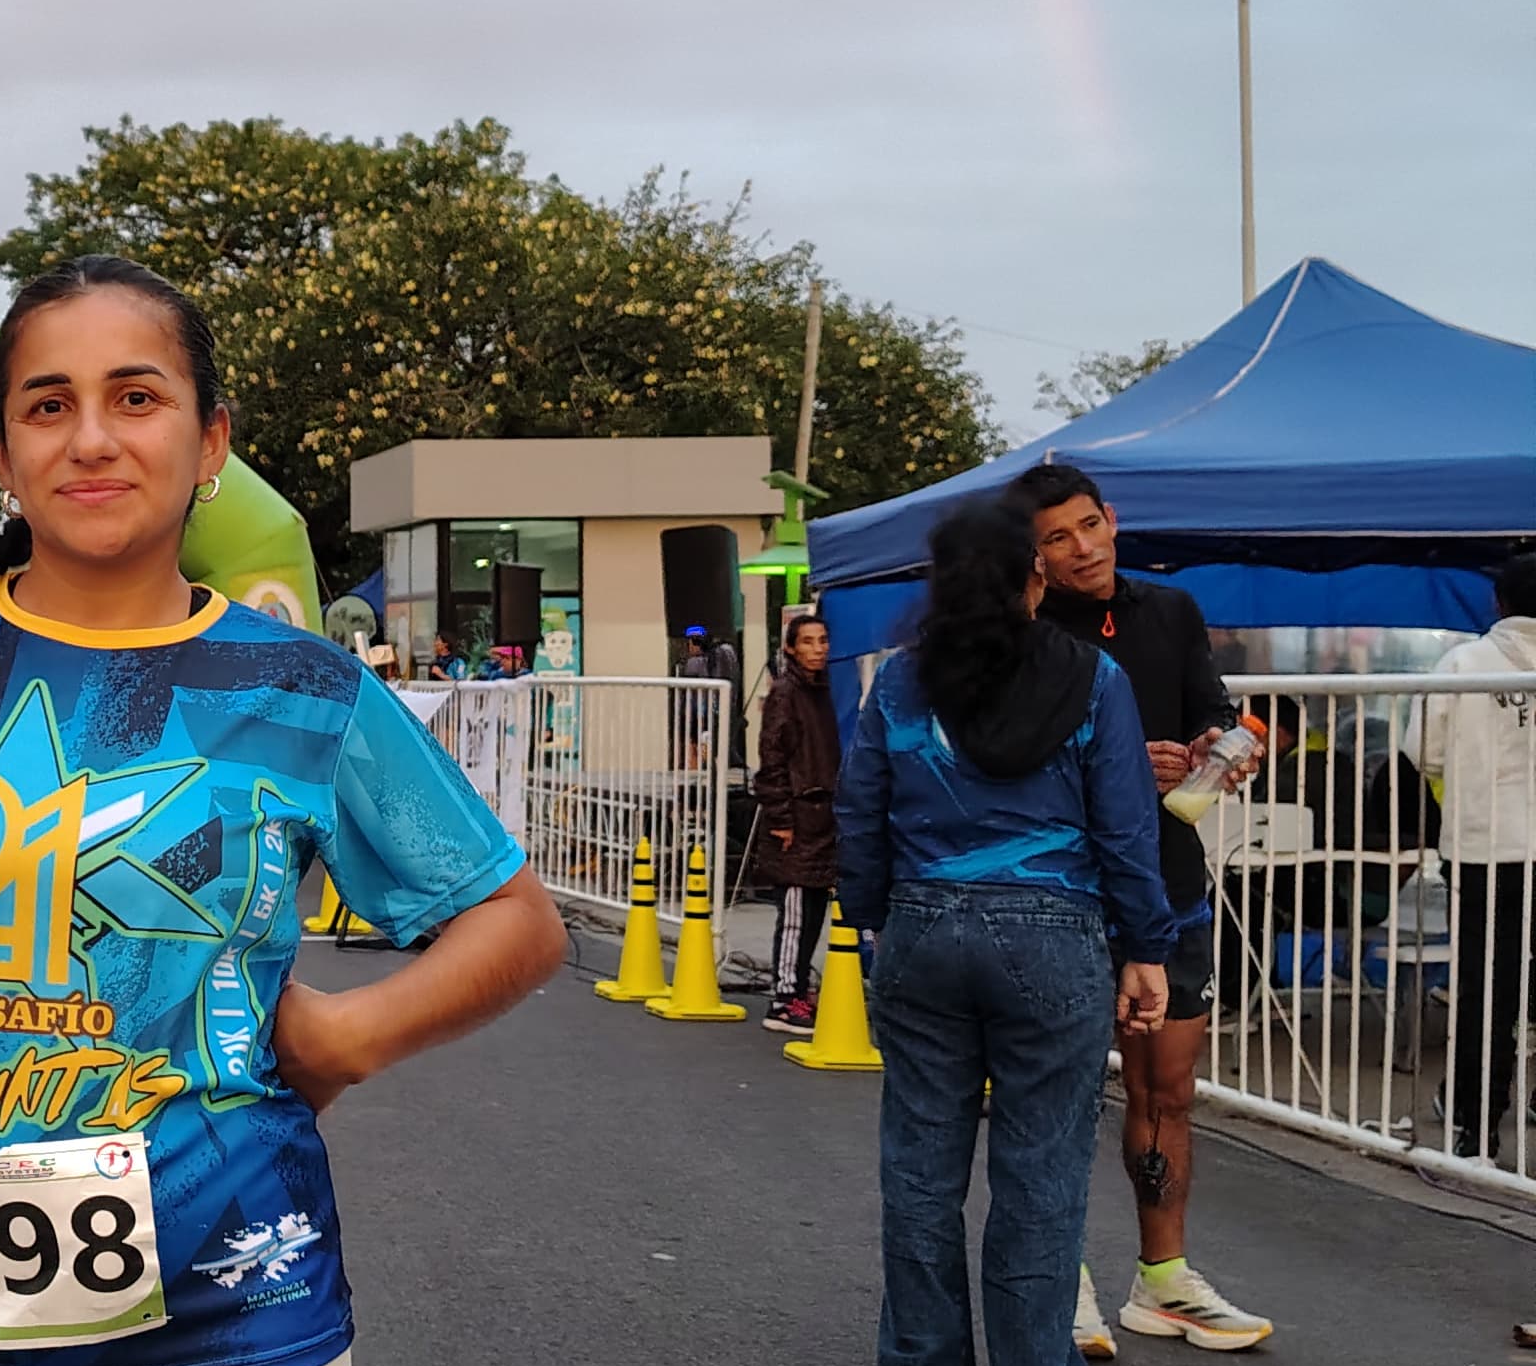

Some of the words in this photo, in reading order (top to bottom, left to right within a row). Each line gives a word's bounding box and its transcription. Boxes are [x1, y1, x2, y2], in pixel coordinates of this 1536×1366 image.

[252, 885, 279, 922] 5K
[212, 945, 241, 992] 10K
[215, 1026, 251, 1076] 21K
[240, 1287, 312, 1314] ARGENTINAS
[247, 1279, 306, 1303] MALVINAS
